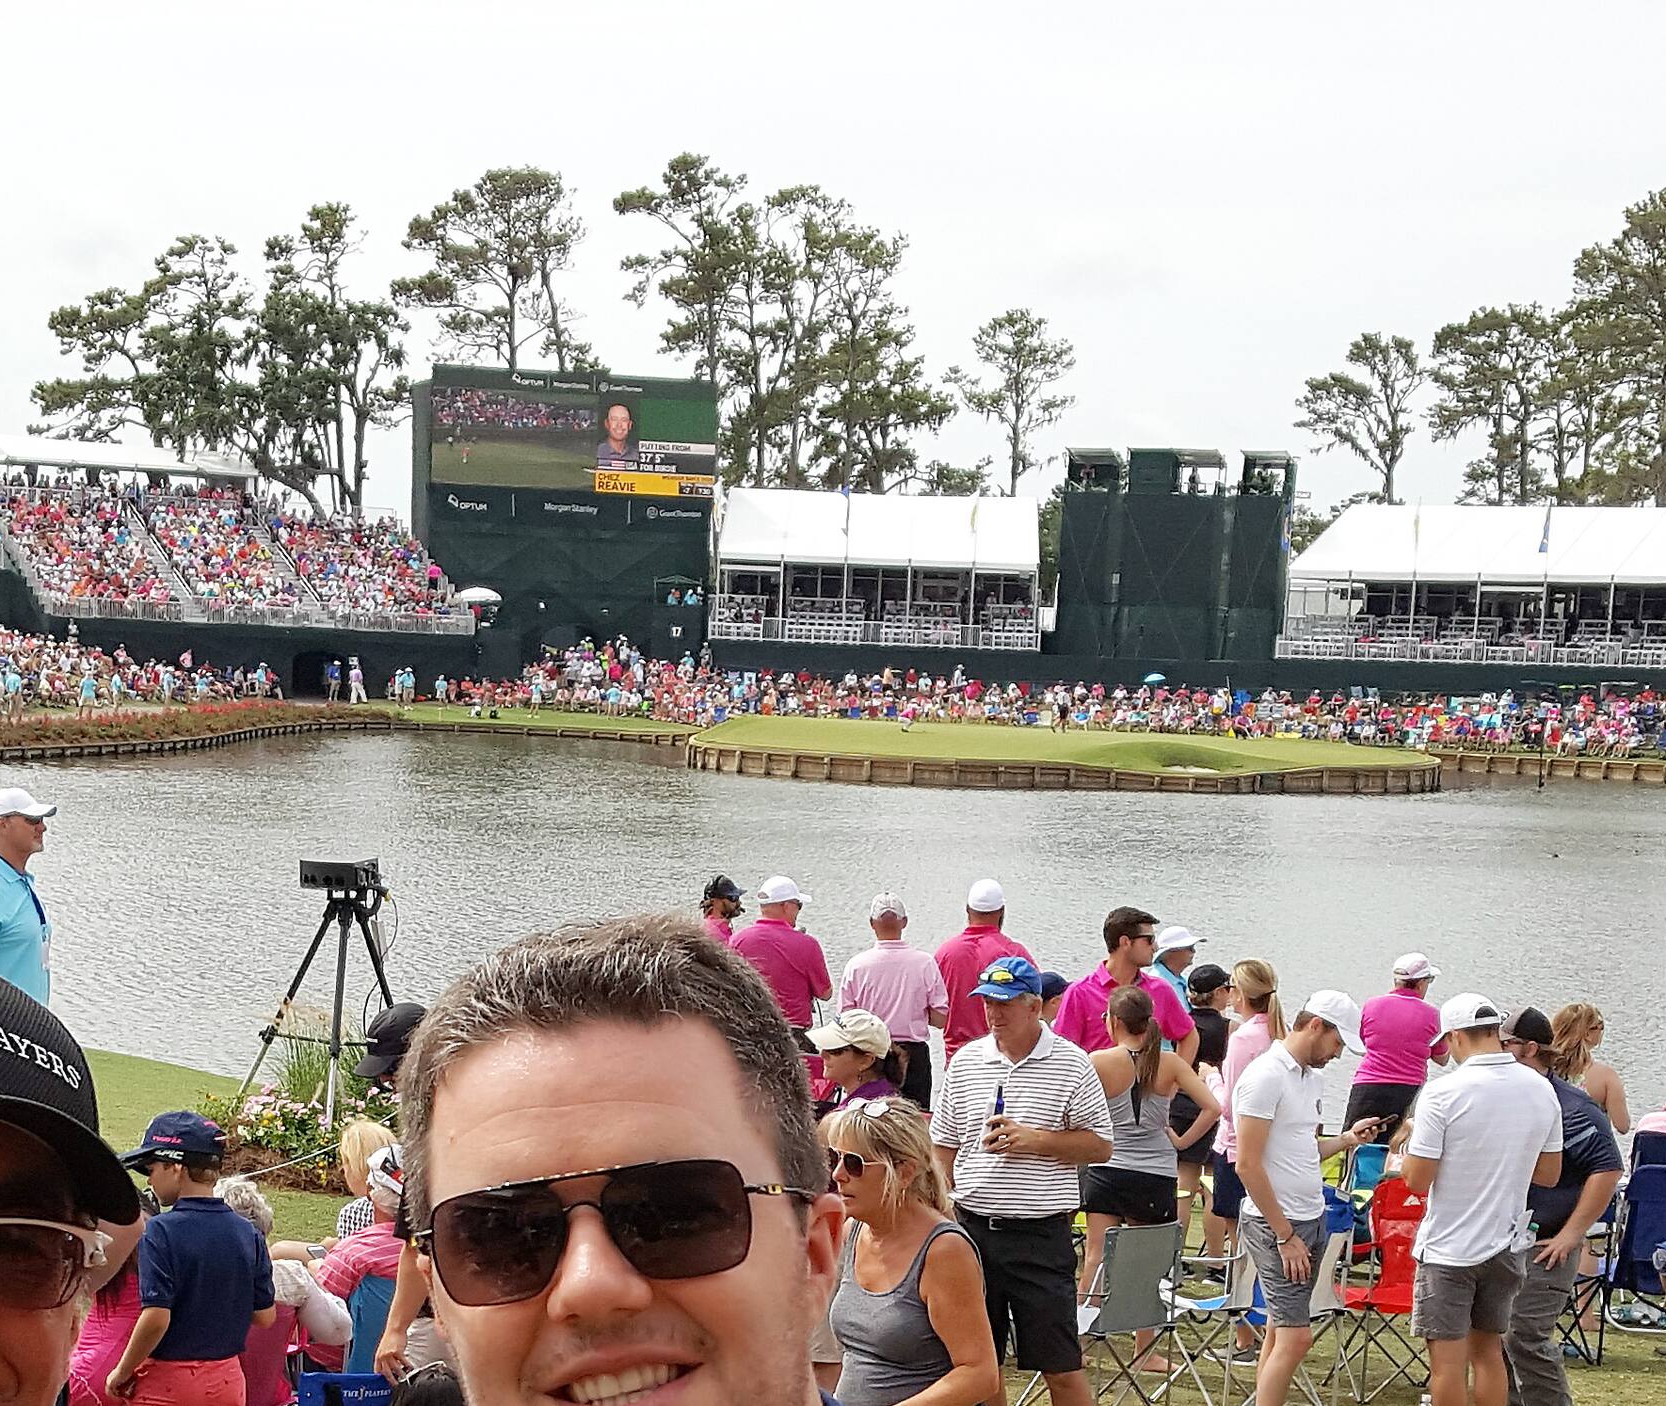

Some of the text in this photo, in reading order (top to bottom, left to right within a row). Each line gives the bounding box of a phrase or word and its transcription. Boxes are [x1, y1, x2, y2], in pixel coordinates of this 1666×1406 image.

[597, 472, 620, 481] CHEZ
[597, 481, 636, 492] REAVIE
[459, 501, 488, 511] OPTUM
[671, 626, 683, 637] 17
